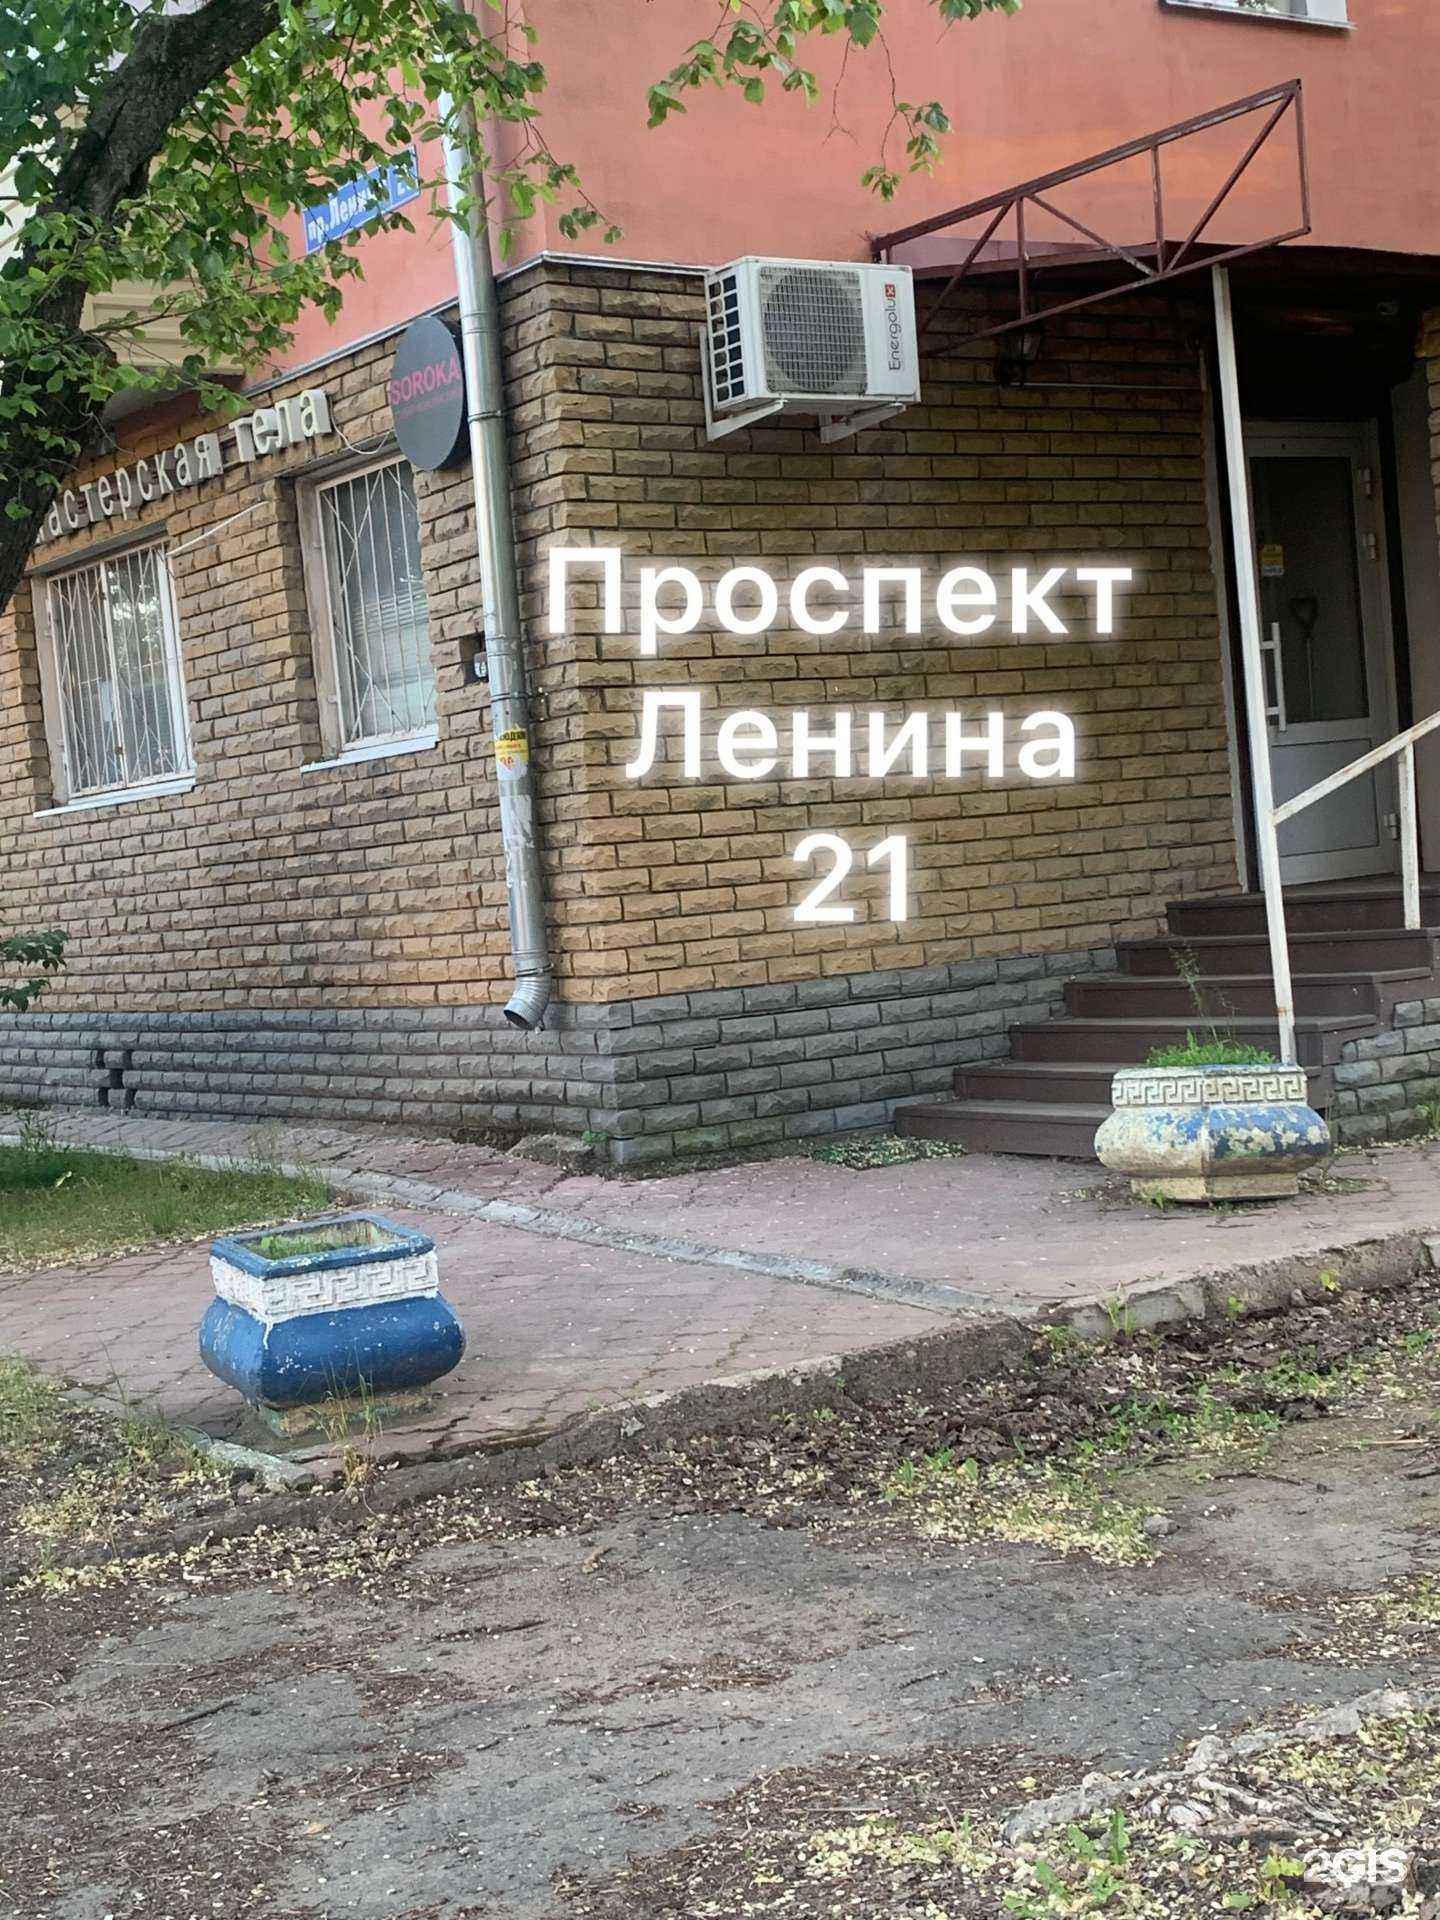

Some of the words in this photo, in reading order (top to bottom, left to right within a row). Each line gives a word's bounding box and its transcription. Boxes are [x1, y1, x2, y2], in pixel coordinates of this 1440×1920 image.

[884, 284, 902, 370] Energolux
[390, 354, 461, 404] SOROKA
[229, 389, 331, 462] тела
